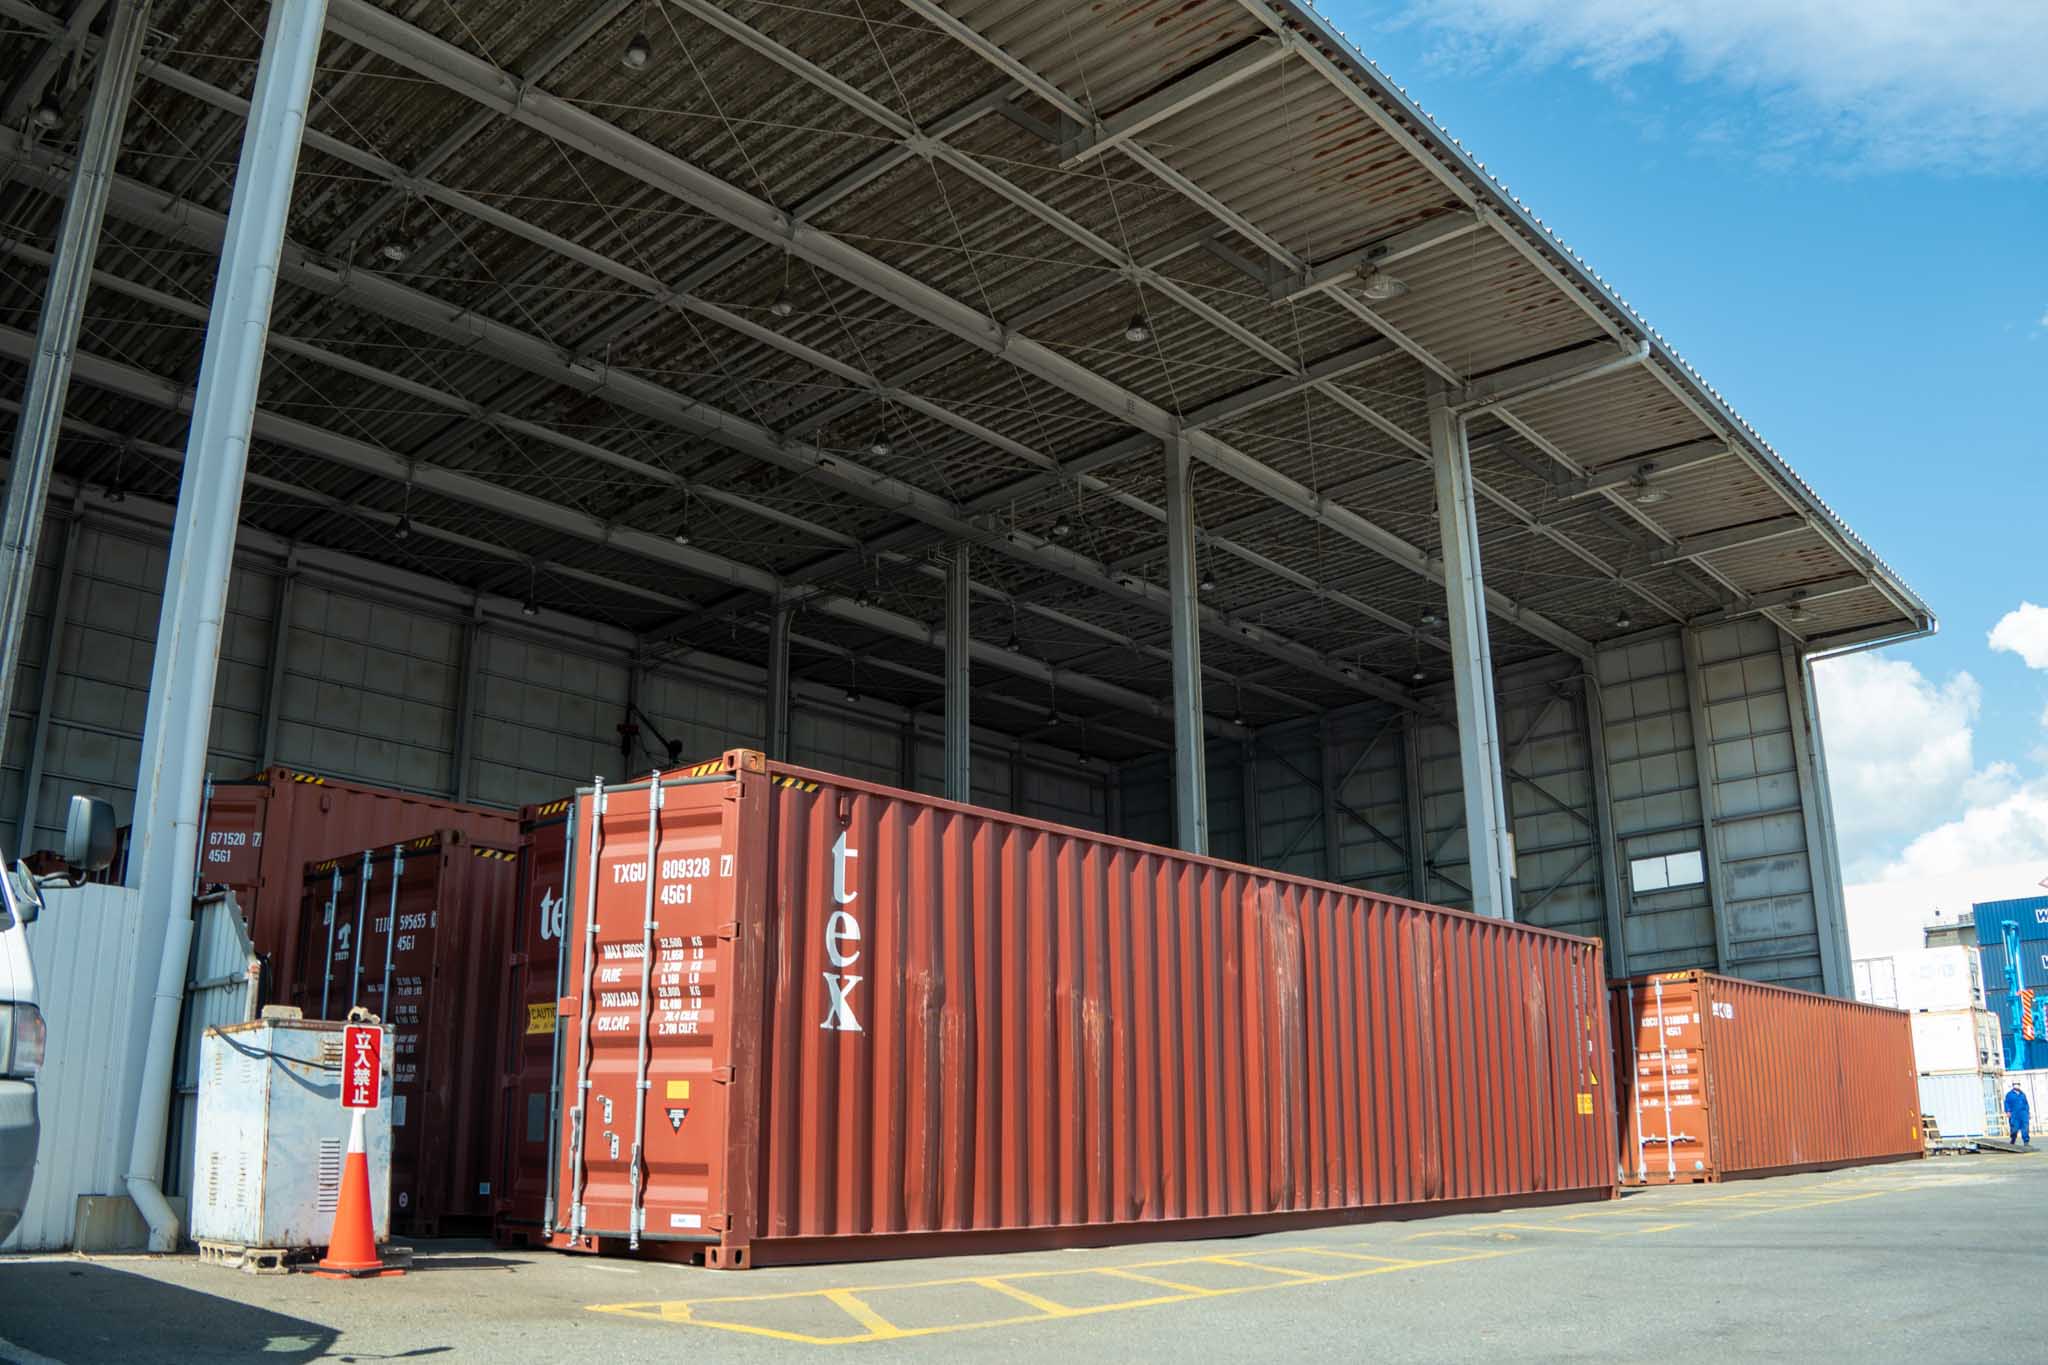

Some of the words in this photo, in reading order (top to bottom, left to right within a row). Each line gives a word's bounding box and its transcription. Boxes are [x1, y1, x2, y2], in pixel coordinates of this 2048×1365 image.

[209, 832, 246, 846] 671520
[252, 832, 262, 847] 7
[208, 849, 231, 863] 45G1
[613, 862, 646, 883] TXGU
[662, 857, 710, 879] 809328
[720, 855, 733, 876] 7
[660, 884, 692, 904] 45G1
[399, 913, 426, 930] 595655
[540, 887, 563, 940] te
[820, 831, 863, 1031] tex
[397, 935, 415, 951] 45G1
[603, 944, 622, 960] MAX
[601, 991, 639, 1008] PAYLOAD
[530, 1006, 556, 1020] CAUTI
[352, 1031, 372, 1104] 立入禁止
